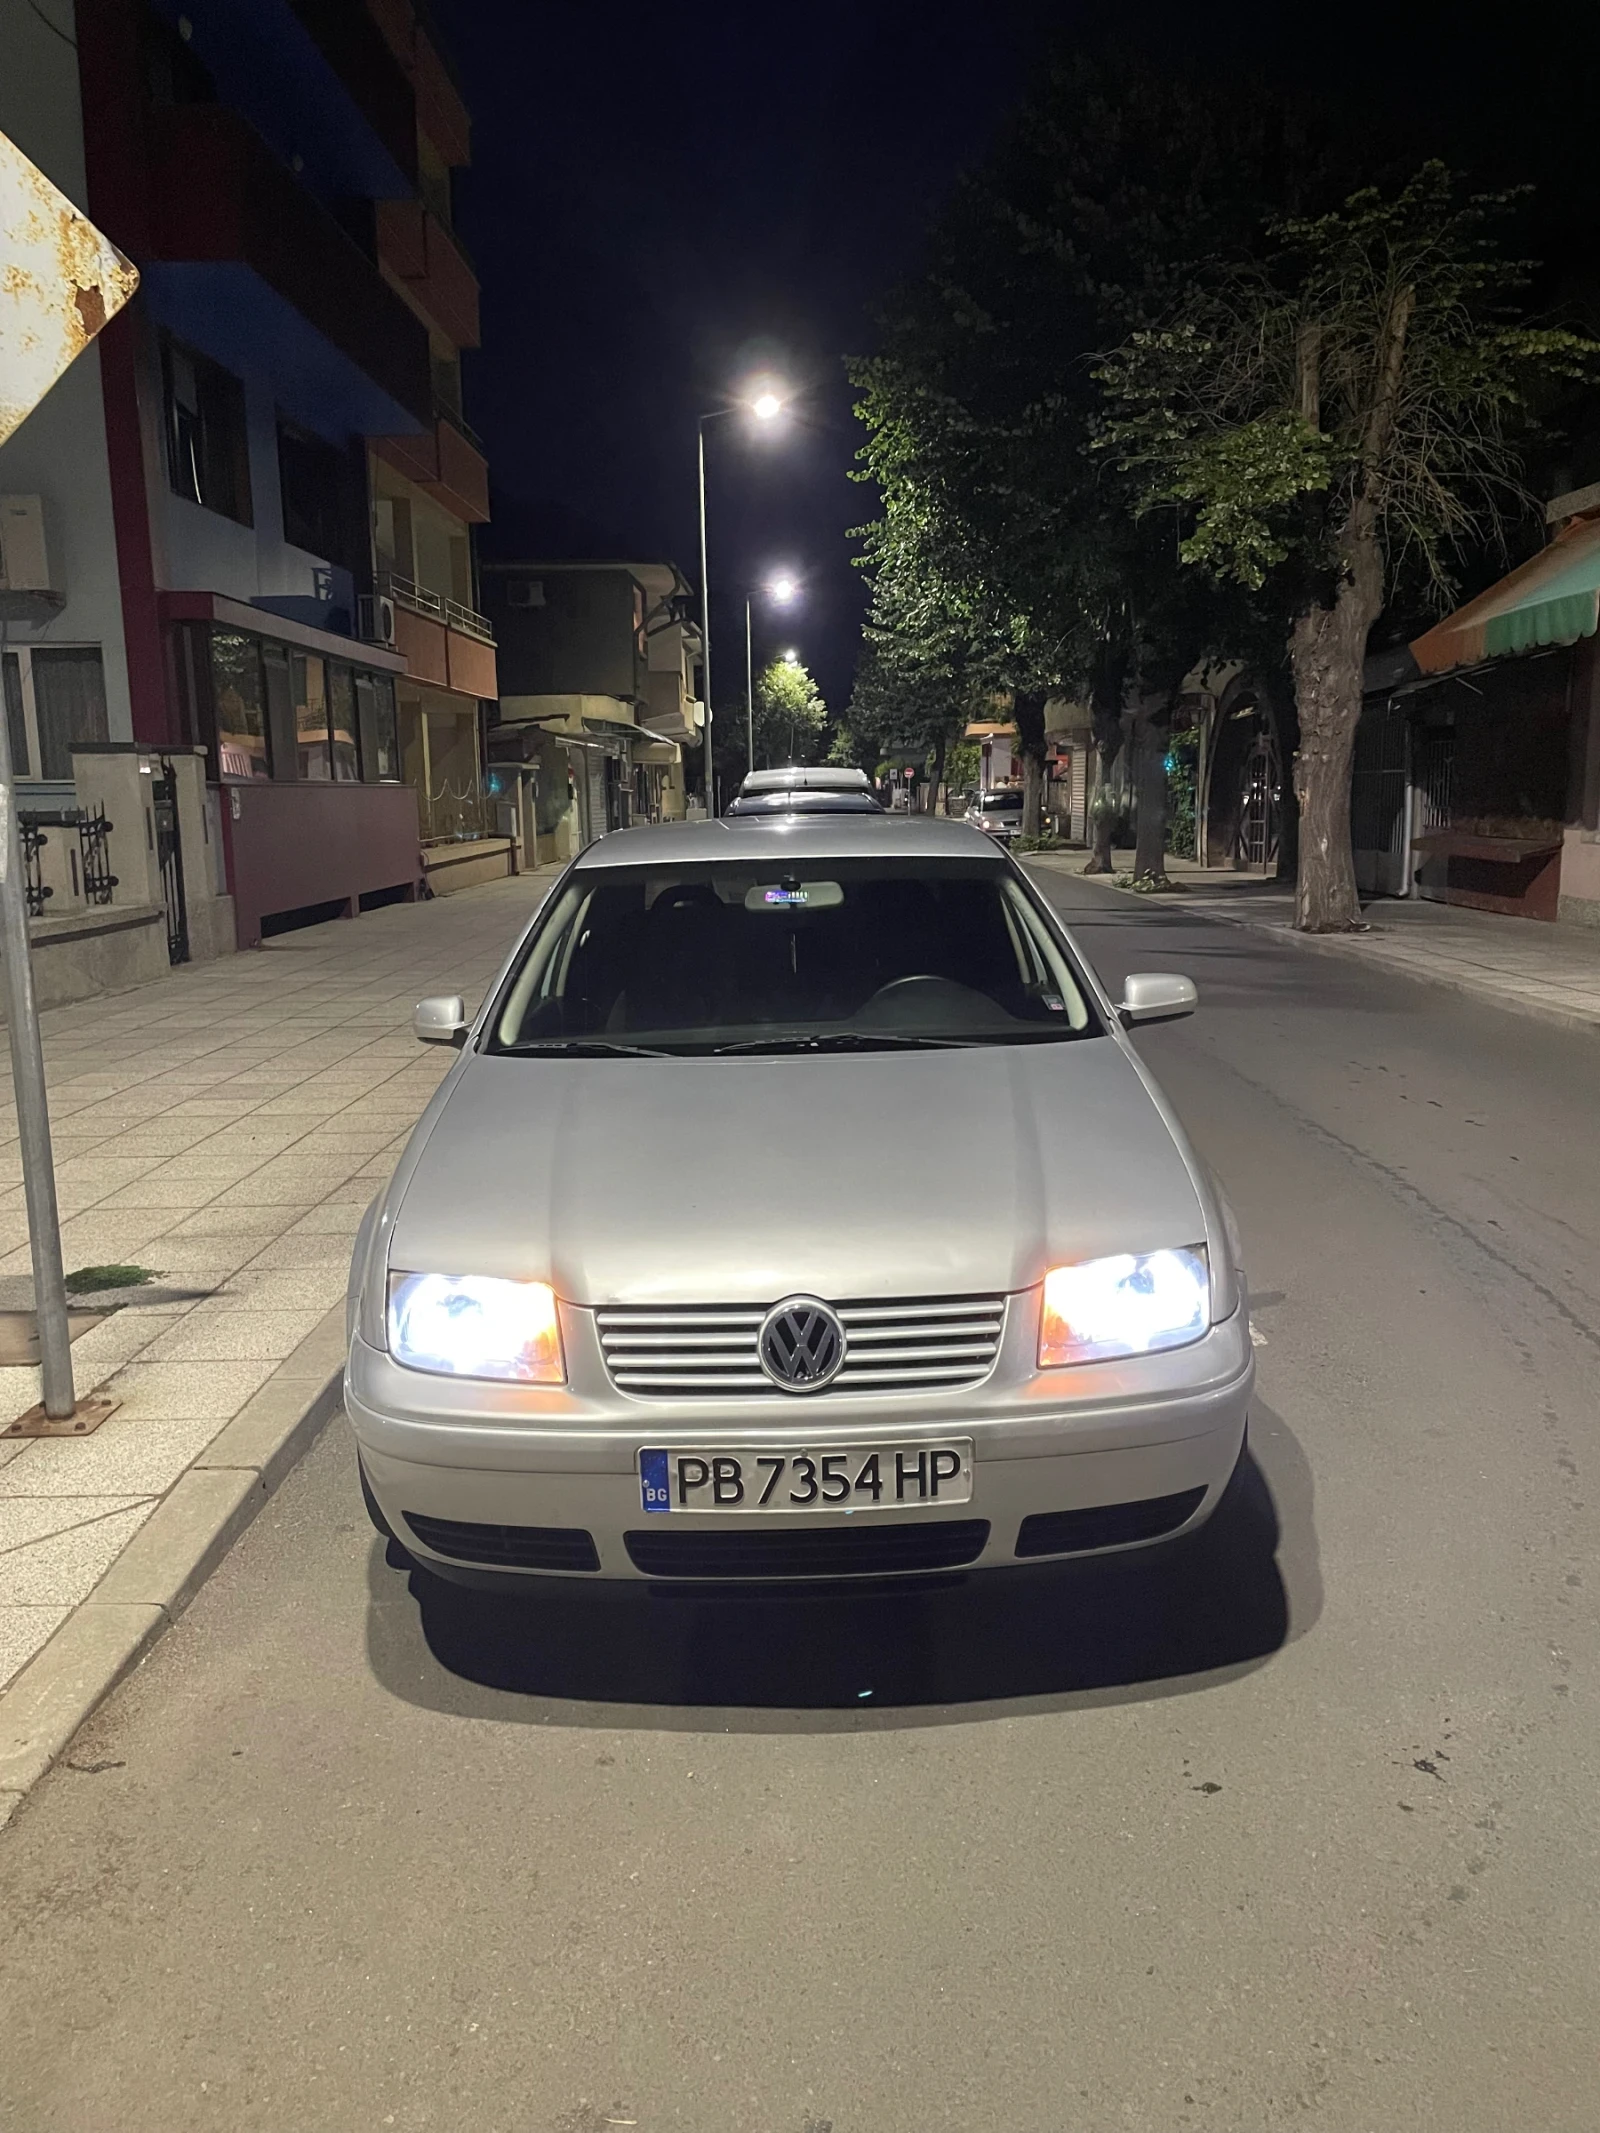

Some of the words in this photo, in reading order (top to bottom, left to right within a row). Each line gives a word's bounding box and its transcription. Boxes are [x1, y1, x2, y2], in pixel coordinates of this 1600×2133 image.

[765, 1305, 839, 1383] VW
[646, 1488, 667, 1501] BG
[677, 1457, 745, 1504] PB
[757, 1453, 883, 1504] 7354
[896, 1450, 961, 1499] HP
